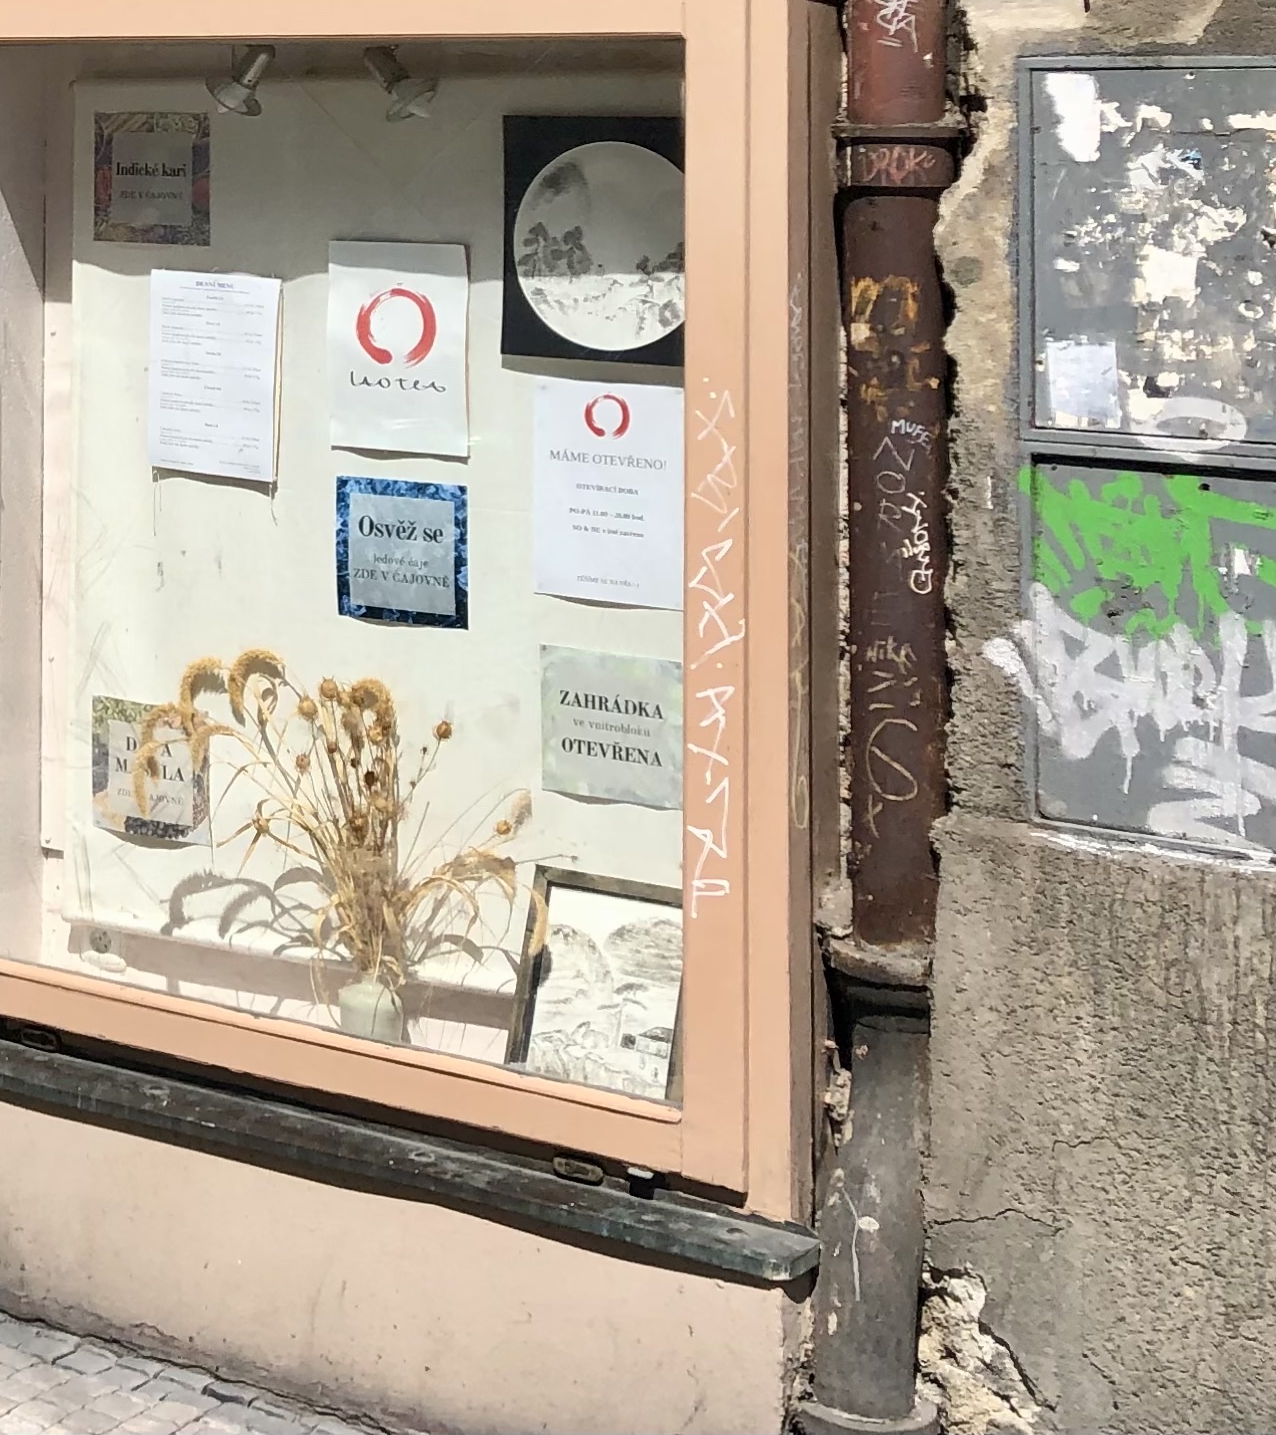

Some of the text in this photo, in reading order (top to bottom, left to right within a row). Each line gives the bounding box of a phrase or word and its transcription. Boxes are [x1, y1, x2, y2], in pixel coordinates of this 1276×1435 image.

[116, 162, 186, 177] Indické kari
[550, 449, 667, 471] MÁME OTEVŘENO!
[358, 515, 444, 543] Osvěž se
[353, 568, 450, 588] ZDE V ČAJOVNĚ
[560, 689, 664, 720] ZAHRÁDKA
[561, 736, 663, 767] OTEVŘENA
